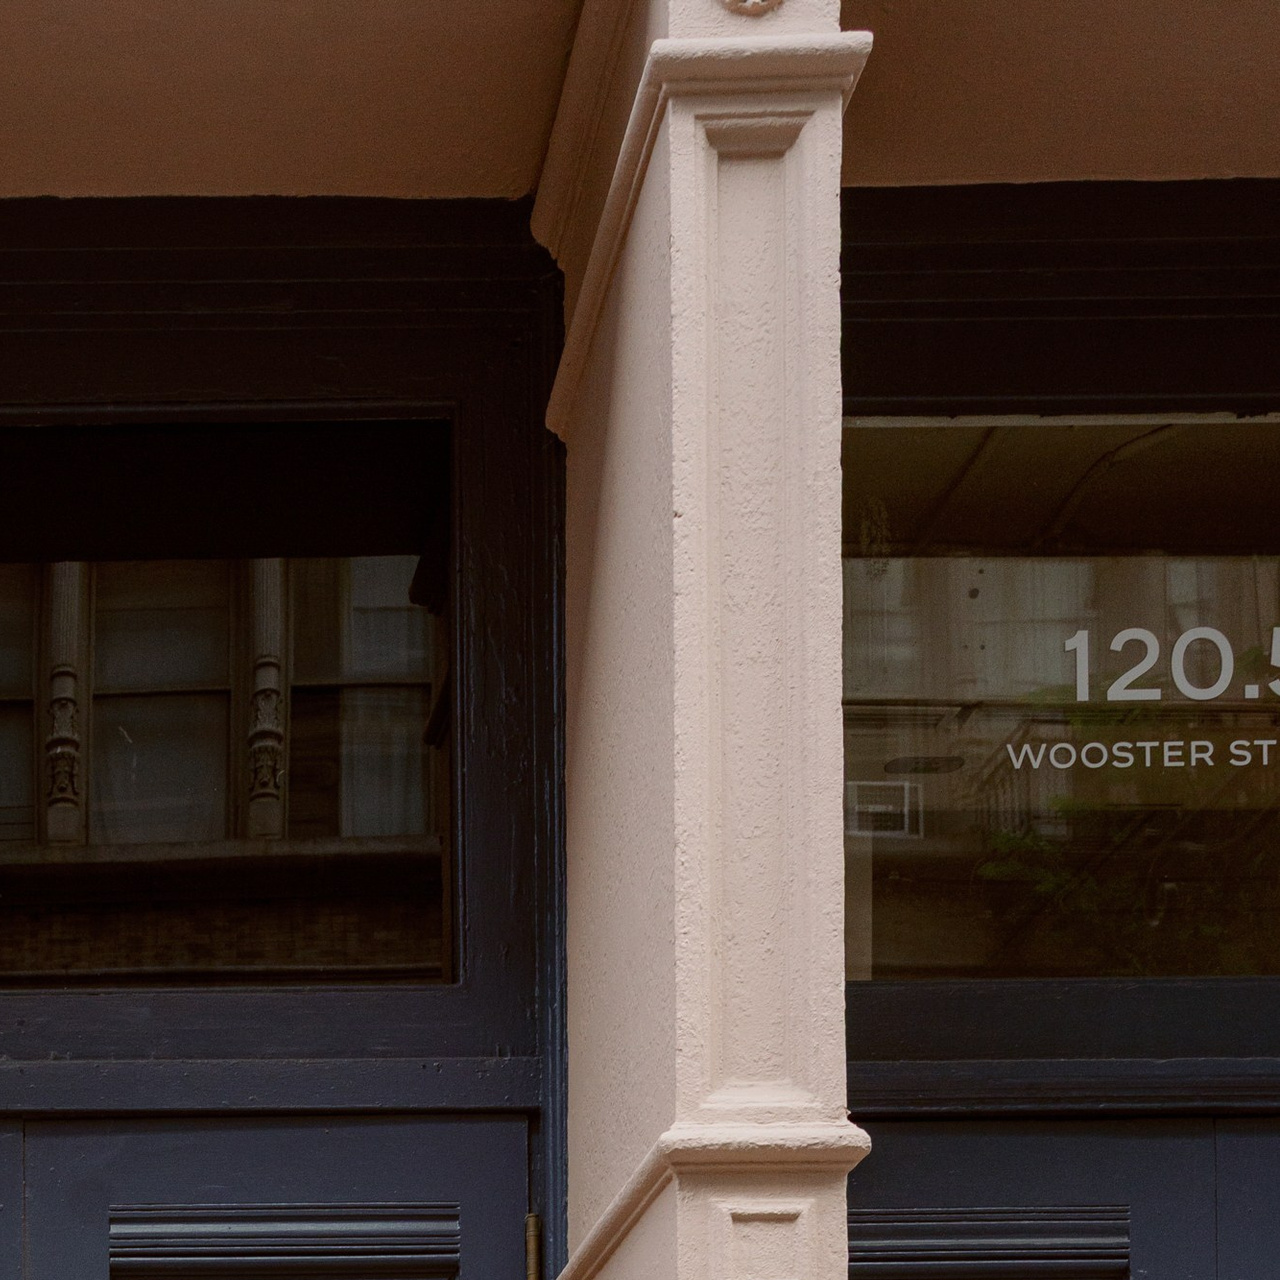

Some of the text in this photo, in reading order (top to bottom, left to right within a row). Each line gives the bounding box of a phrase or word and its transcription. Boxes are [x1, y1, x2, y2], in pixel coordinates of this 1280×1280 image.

[1065, 627, 1280, 701] 120.
[1006, 740, 1277, 769] WOOSTER ST
